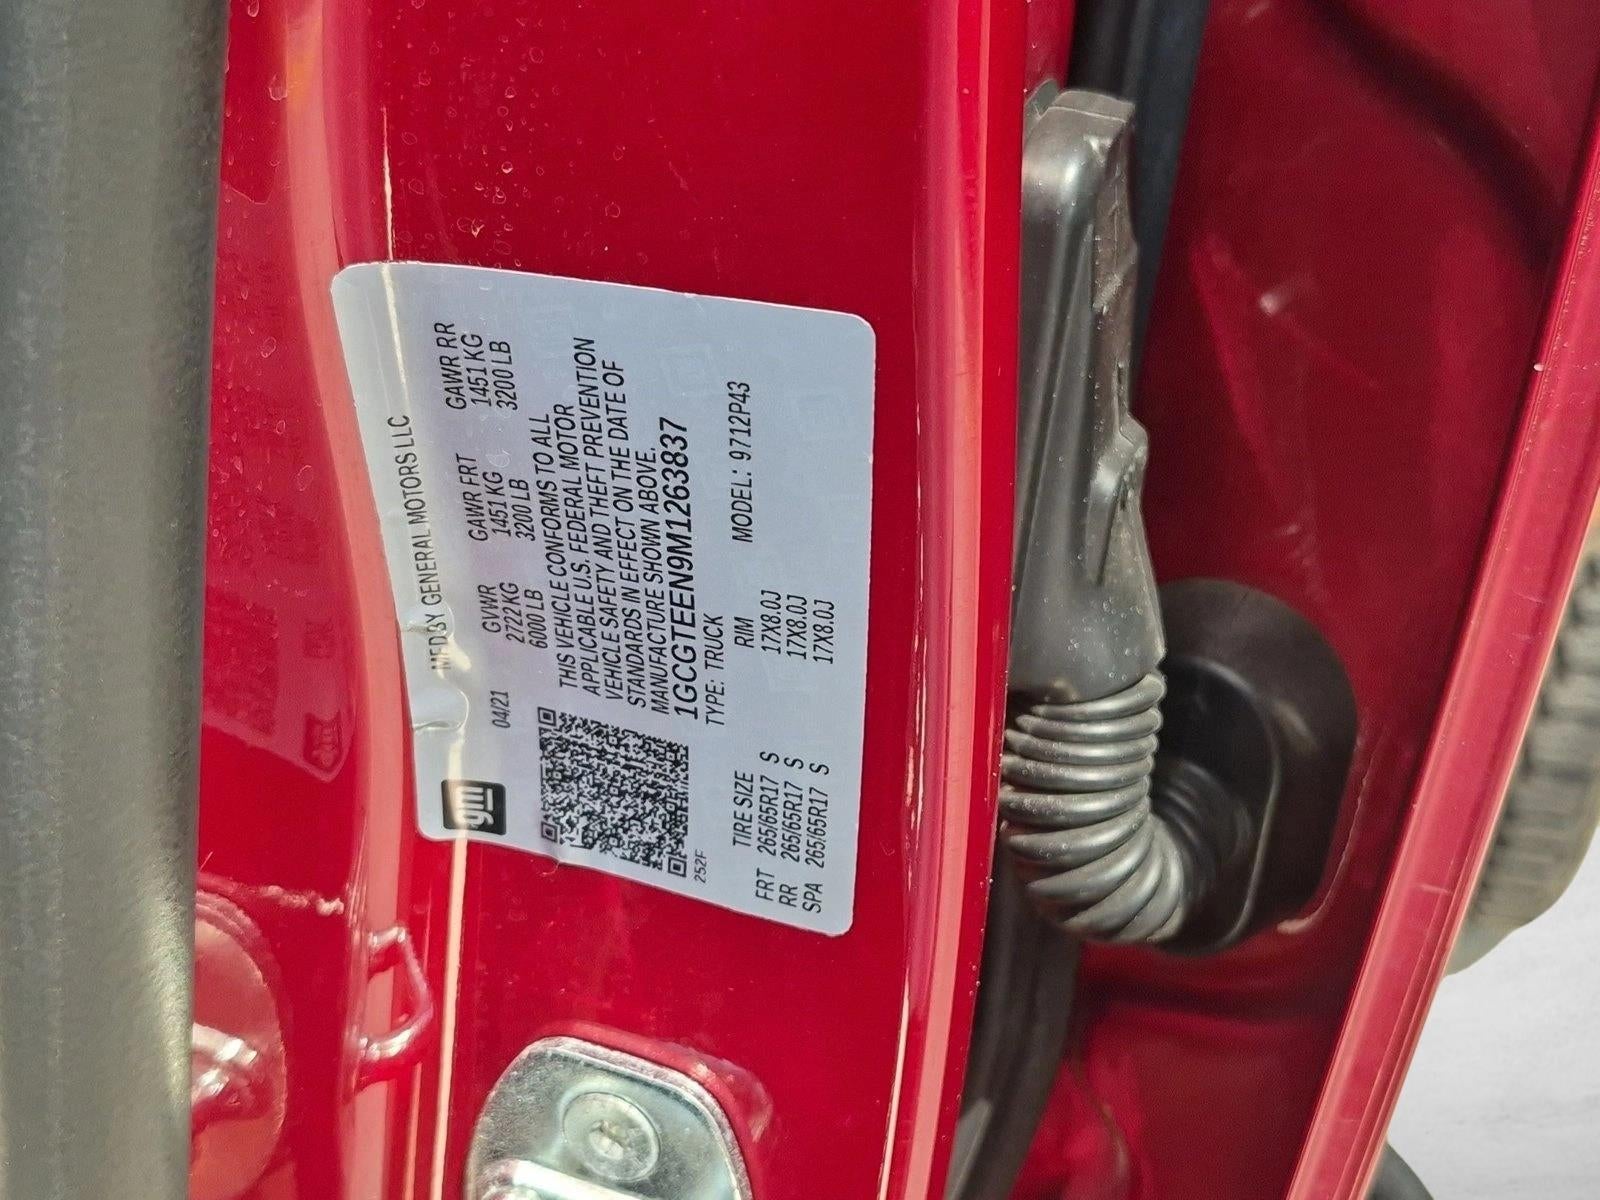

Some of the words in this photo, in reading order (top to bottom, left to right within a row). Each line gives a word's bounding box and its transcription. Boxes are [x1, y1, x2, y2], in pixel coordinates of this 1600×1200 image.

[434, 322, 458, 349] RR
[460, 334, 486, 363] KG
[489, 341, 512, 365] LB
[439, 355, 467, 410] GAWR
[466, 367, 491, 407] 1451
[492, 368, 518, 410] 3200
[602, 360, 625, 387] OF
[573, 337, 604, 458] PREVENTION
[604, 392, 629, 441] DATE
[387, 415, 415, 448] LLC
[529, 414, 552, 448] ALL
[553, 404, 580, 471] MOTOR
[727, 381, 752, 461] 9712P43
[456, 453, 480, 486] FRT
[532, 452, 555, 475] TO
[609, 446, 632, 480] THE
[635, 447, 660, 515] ABOVE.
[394, 452, 431, 525] MOTORS
[483, 471, 505, 496] KG
[508, 478, 530, 500] LB
[585, 462, 609, 517] THEFT
[612, 486, 633, 513] ON
[462, 491, 489, 541] GAWR
[488, 501, 511, 537] 1451
[511, 504, 535, 541] 3200
[561, 476, 589, 554] FEDERAL
[731, 470, 753, 543] MODEL:
[536, 480, 567, 576] CONFORMS
[591, 524, 614, 561] AND
[410, 529, 442, 605] GENERAL
[615, 516, 639, 584] EFFECT
[640, 518, 664, 584] SHOWN
[659, 416, 699, 720] 1GCGTEEN9M1263837
[499, 582, 519, 605] KG
[570, 560, 592, 590] U.S.
[620, 586, 641, 603] IN
[477, 584, 501, 633] GVWR
[524, 589, 544, 611] LB
[549, 580, 574, 648] VEHICLE
[595, 563, 619, 629] SAFETY
[425, 613, 447, 632] BY
[503, 607, 525, 644] 2722
[526, 613, 548, 649] 6000
[702, 613, 724, 670] TRUCK
[734, 616, 754, 649] RIM
[760, 589, 782, 655] 17X8.0J
[786, 594, 807, 660] 17X8.0J
[813, 599, 835, 665] 17X8.0J
[574, 593, 601, 697] APPLICABLE
[621, 607, 647, 708] STANDARDS
[645, 588, 670, 715] MANUFACTURE
[556, 653, 578, 688] THIS
[601, 631, 624, 700] VEHICLE
[490, 690, 511, 729] 04/21
[705, 679, 725, 726] TYPE:
[759, 751, 779, 764] S
[784, 757, 804, 770] S
[809, 763, 830, 776] S
[733, 770, 754, 809] SIZE
[733, 810, 753, 847] TIRE
[757, 775, 779, 857] 265/65R17
[780, 781, 803, 863] 265/65R17
[805, 787, 828, 869] 265/65R17
[694, 849, 707, 884] 252F
[756, 867, 775, 902] FRT
[779, 883, 798, 908] RR
[802, 882, 823, 914] SPA
